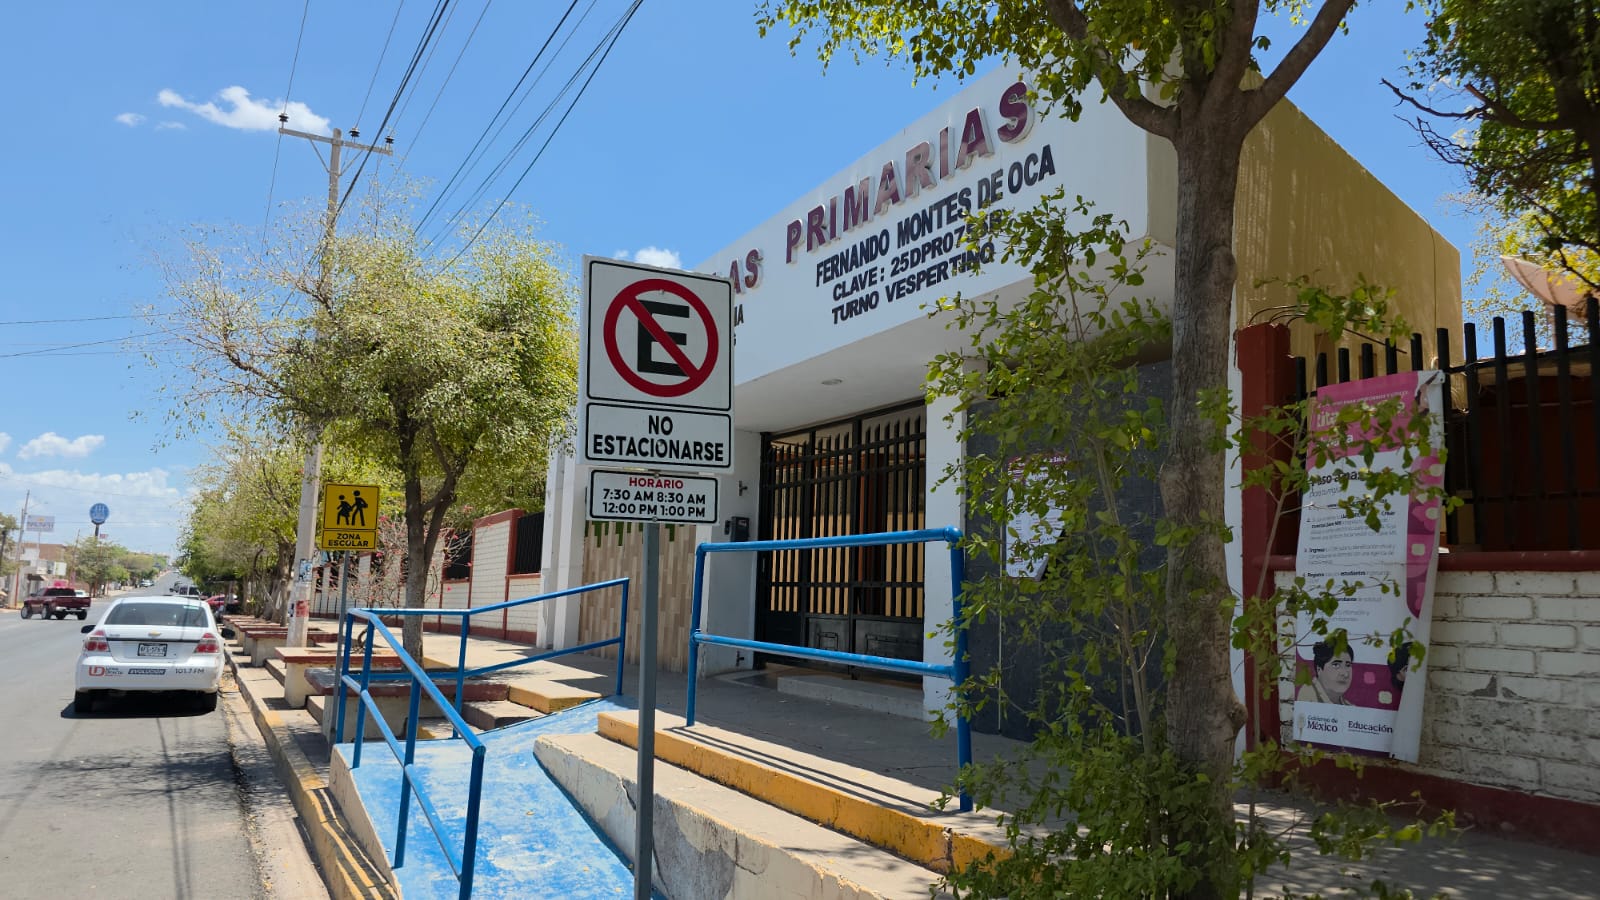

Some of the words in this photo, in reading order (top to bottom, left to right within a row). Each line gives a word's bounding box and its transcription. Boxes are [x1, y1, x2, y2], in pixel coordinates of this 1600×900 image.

[785, 80, 1033, 264] PRIMARIAS
[816, 229, 890, 287] FERNANDO
[897, 187, 972, 249] MONTES
[977, 168, 1004, 209] DE
[1007, 144, 1056, 194] OCA
[831, 291, 879, 325] TURNO
[885, 242, 995, 303] VESPERTINO
[648, 415, 673, 435] NO
[593, 434, 724, 462] ESTACIONARSE
[629, 477, 684, 489] HORARIO
[603, 488, 630, 500] 7:30
[634, 491, 654, 502] AM
[657, 492, 684, 503] 8:30
[686, 494, 706, 505] AM
[602, 502, 636, 514] 12:00
[639, 504, 658, 515] PM
[660, 505, 685, 516] 1:00
[687, 507, 706, 517] PM
[328, 539, 369, 547] ESCOLAR
[1307, 720, 1338, 732] México
[1348, 720, 1393, 733] Educación
